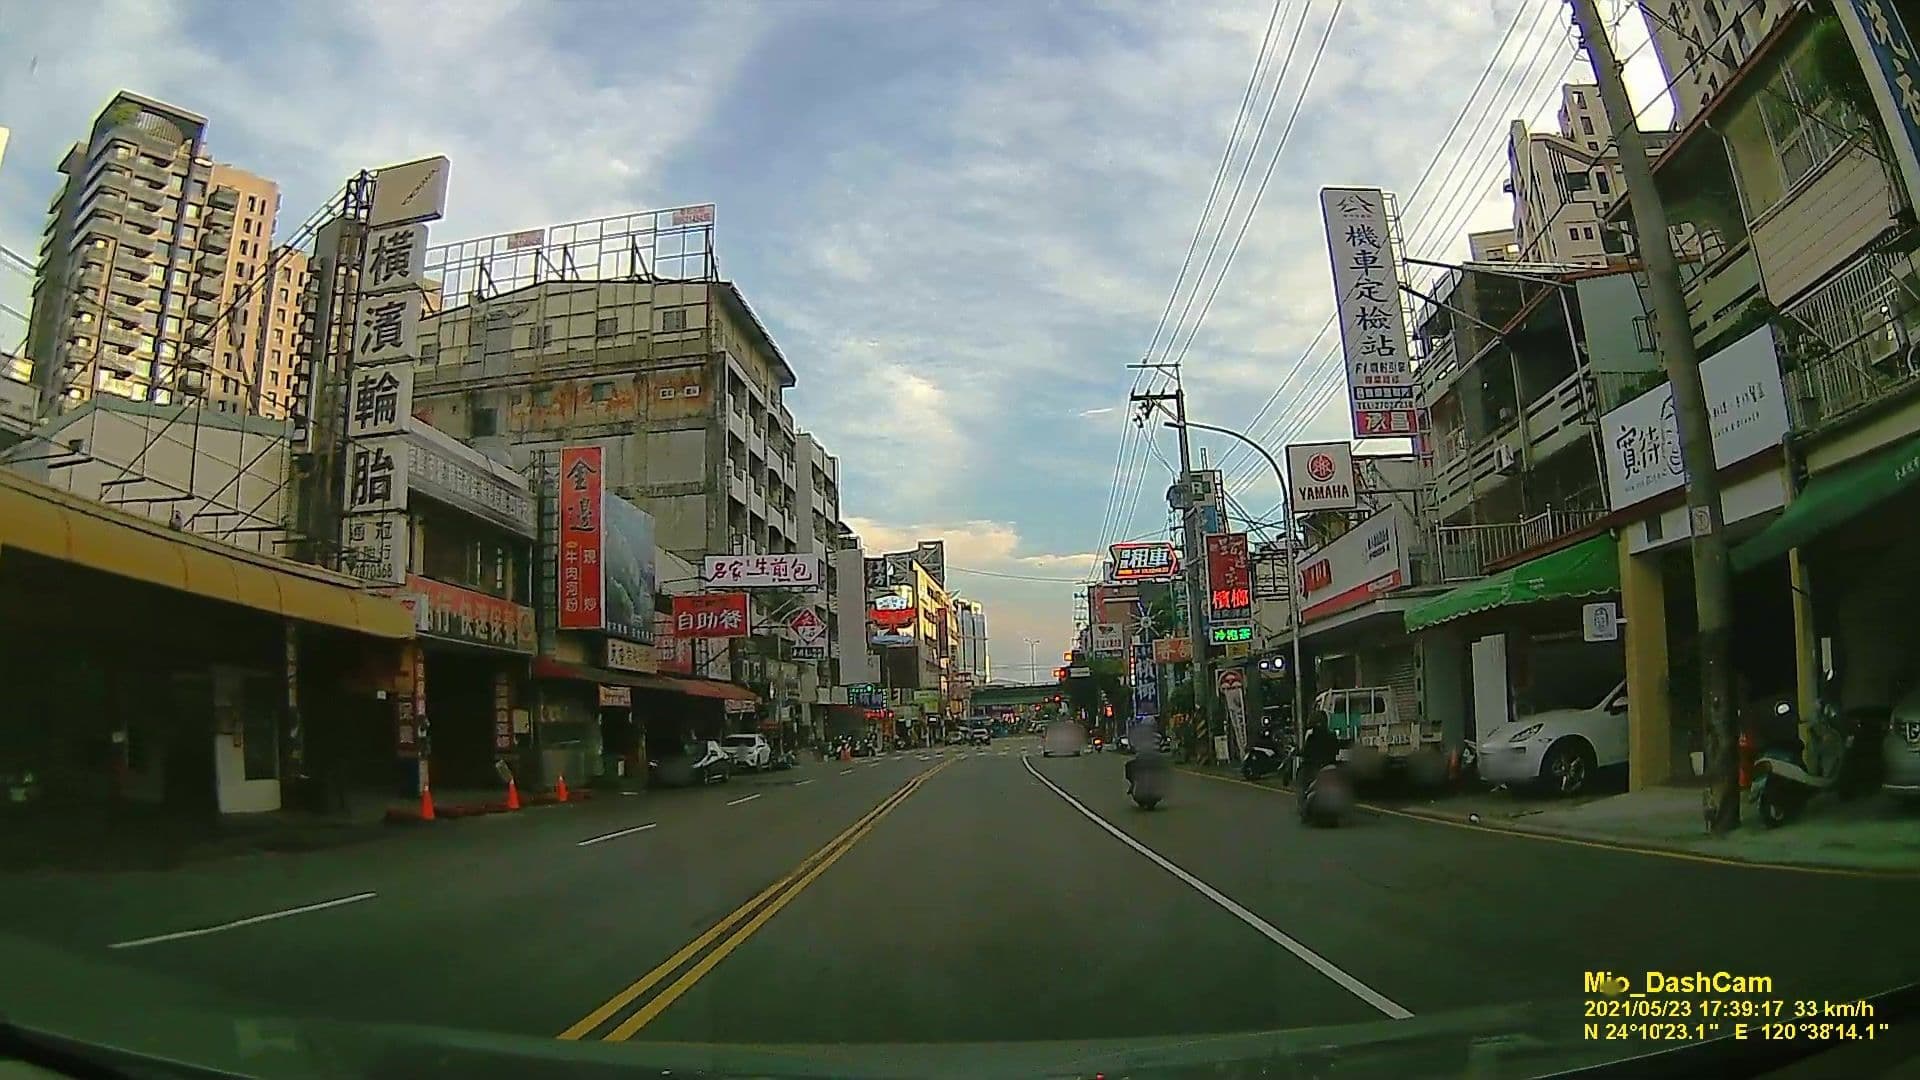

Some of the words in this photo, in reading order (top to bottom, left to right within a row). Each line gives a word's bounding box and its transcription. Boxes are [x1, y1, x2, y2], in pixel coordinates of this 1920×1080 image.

[1346, 224, 1396, 357] 機車定檢站
[352, 229, 414, 507] 橫濱輪胎
[1299, 484, 1350, 501] YAMAHA
[1212, 588, 1249, 610] 檳榔
[677, 609, 742, 631] 自助餐
